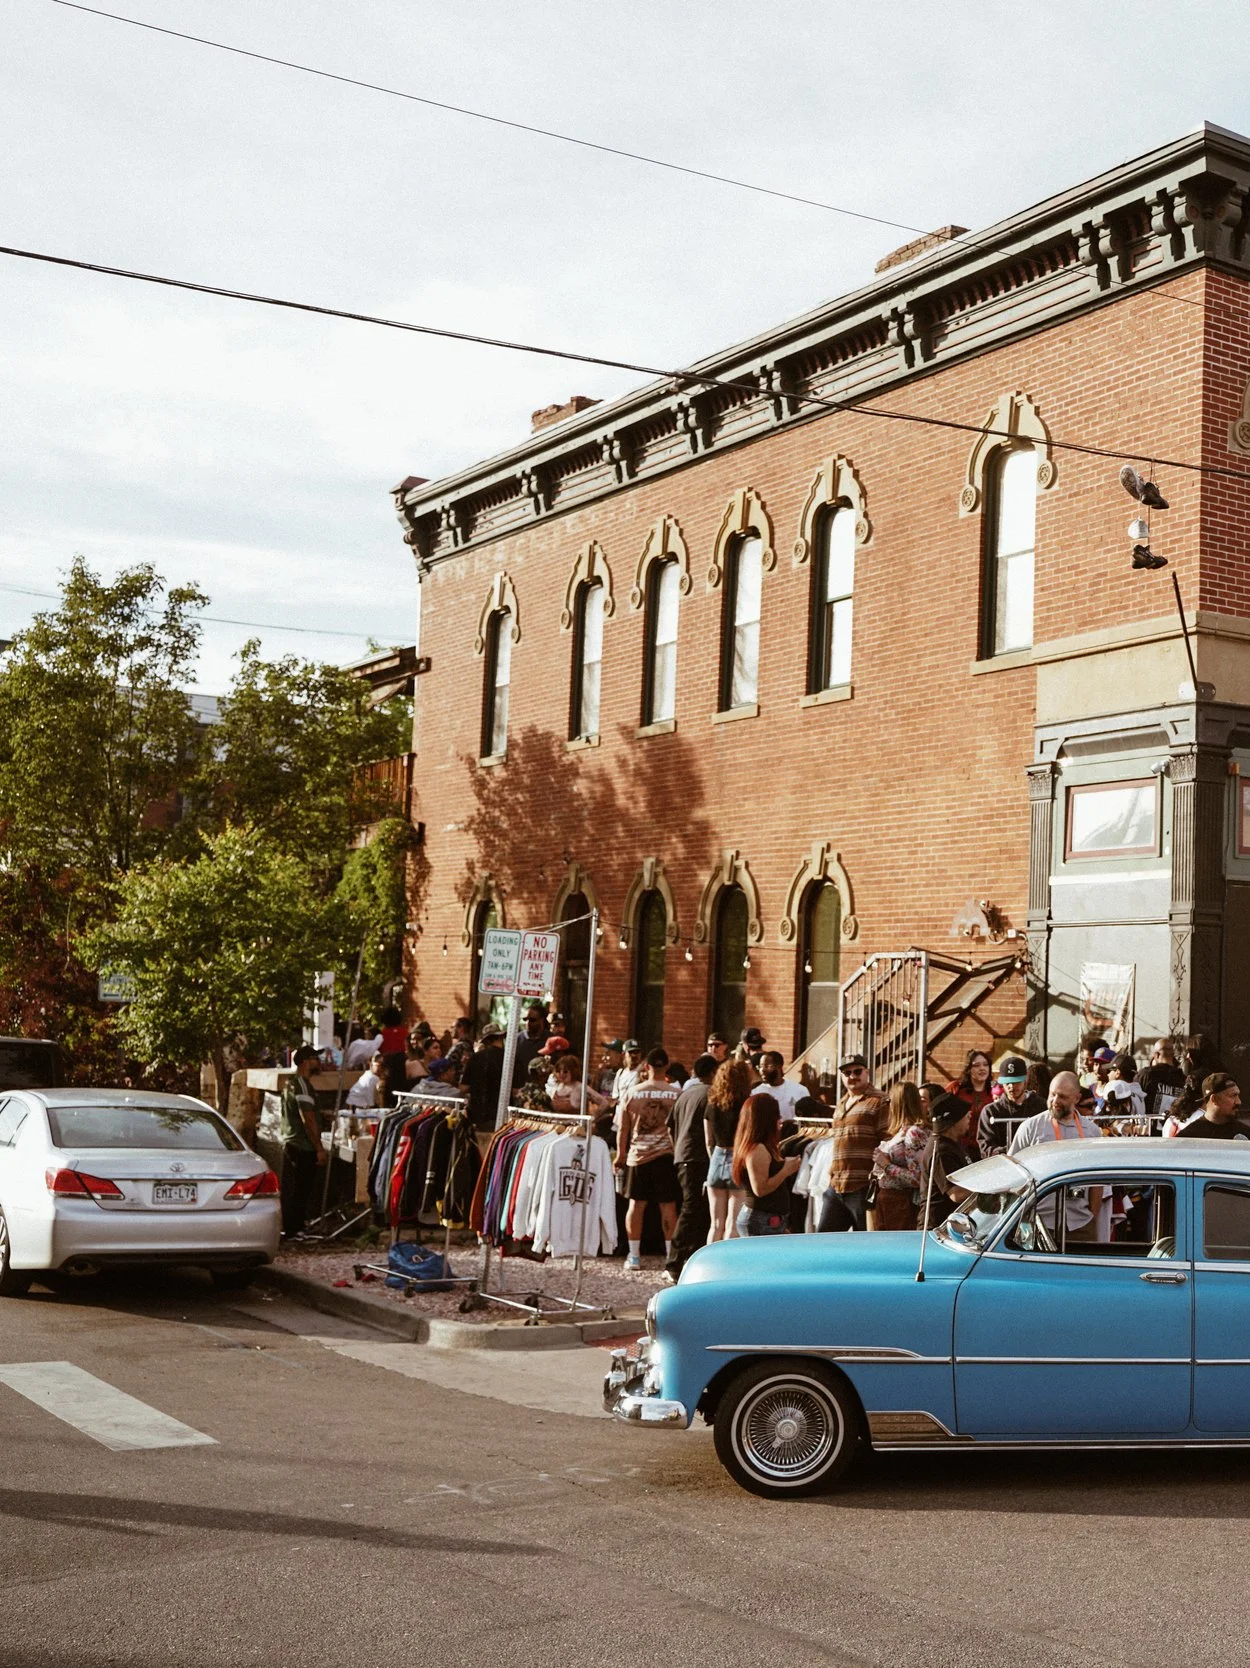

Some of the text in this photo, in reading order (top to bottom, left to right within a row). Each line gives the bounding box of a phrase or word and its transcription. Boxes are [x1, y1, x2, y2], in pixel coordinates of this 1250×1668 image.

[489, 936, 518, 946] LOADING
[533, 936, 548, 949] NO
[492, 948, 512, 958] ONLY
[524, 949, 555, 963] PARKING
[530, 963, 544, 971] ANY
[528, 972, 545, 981] TIME
[1007, 1063, 1015, 1074] S
[651, 1090, 677, 1100] BEATS
